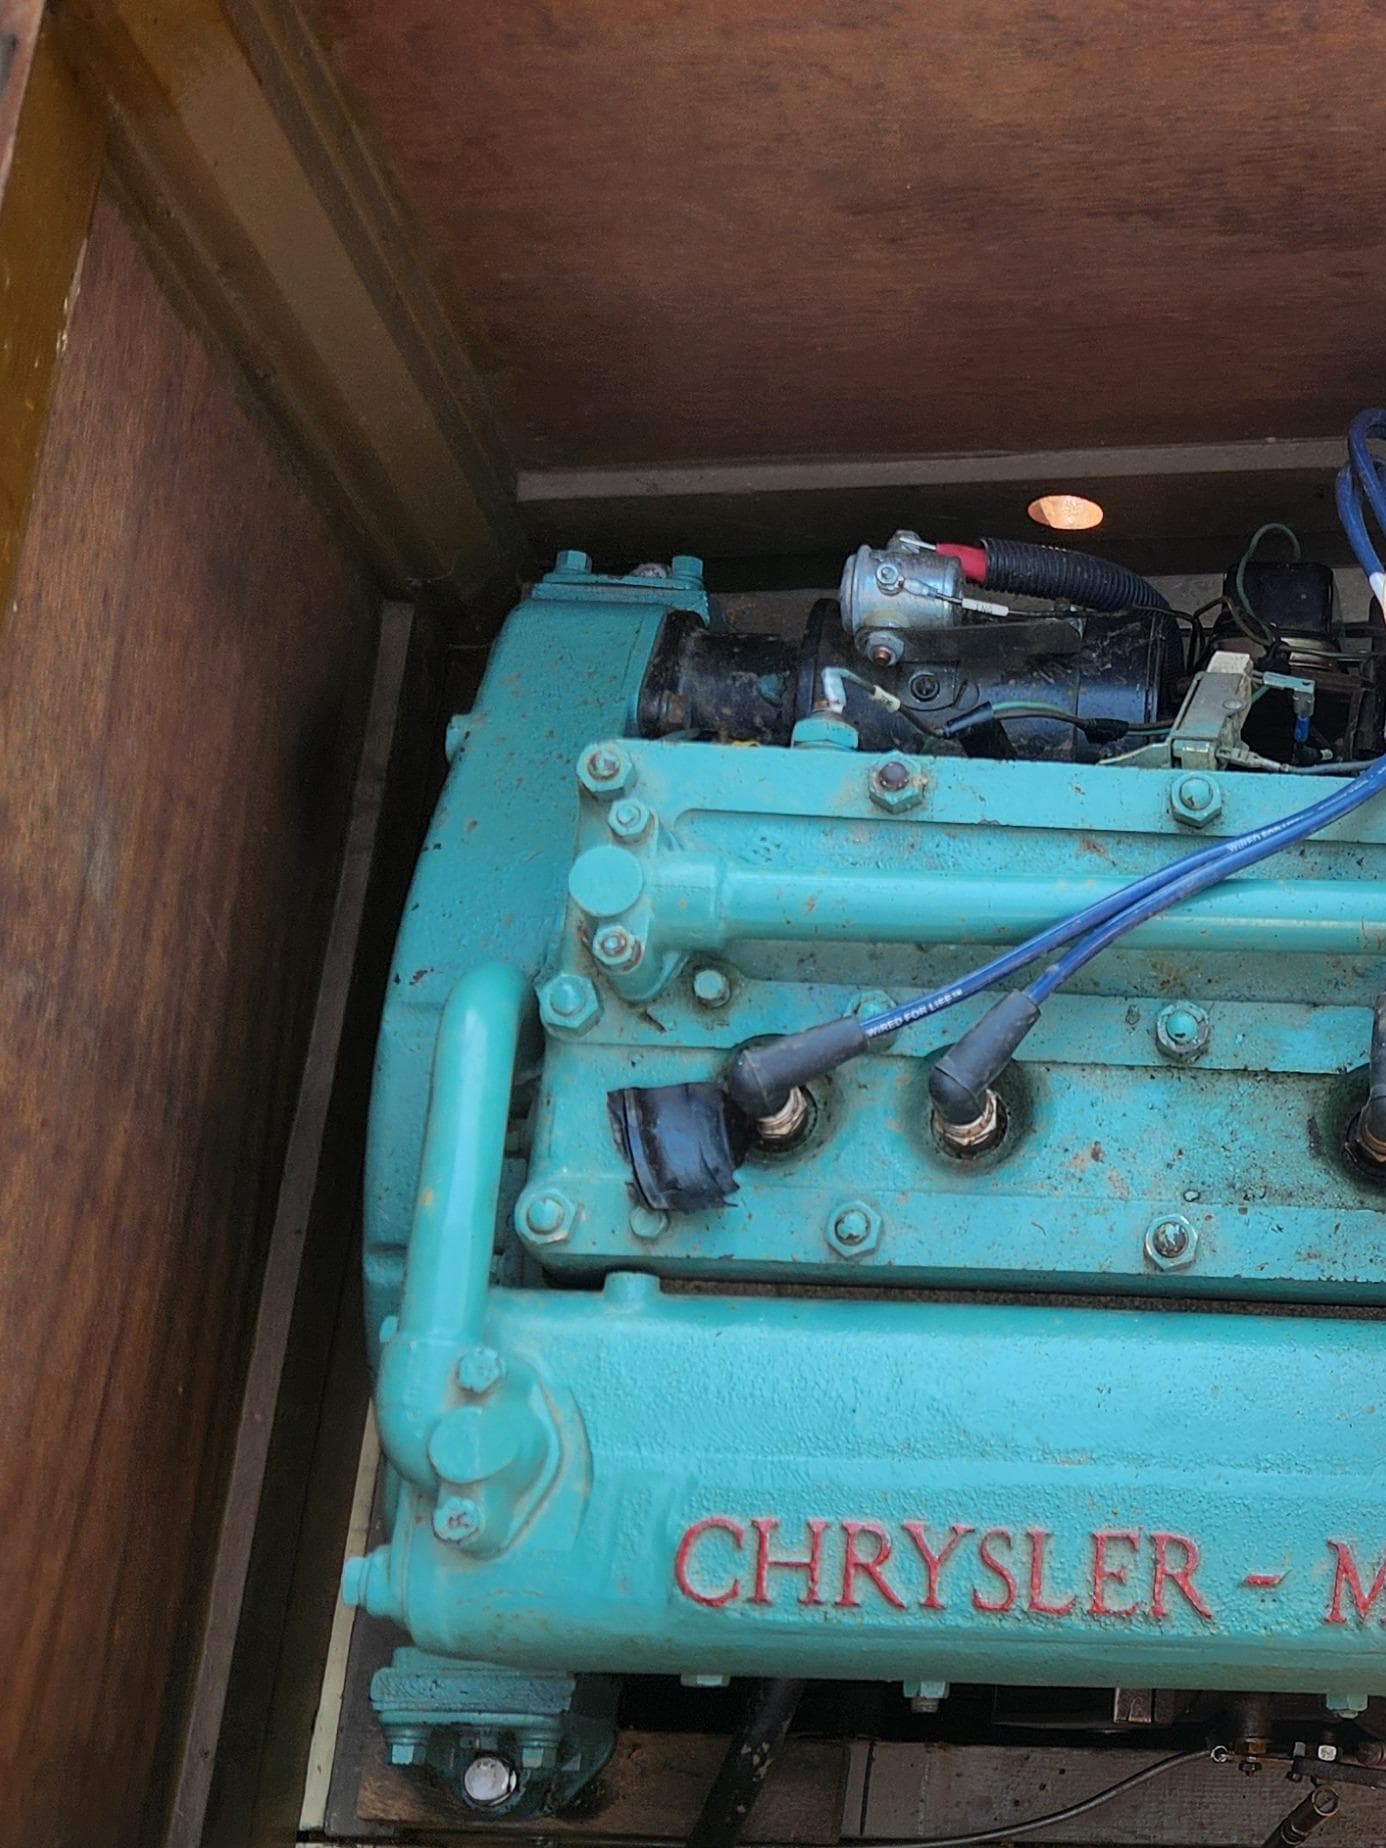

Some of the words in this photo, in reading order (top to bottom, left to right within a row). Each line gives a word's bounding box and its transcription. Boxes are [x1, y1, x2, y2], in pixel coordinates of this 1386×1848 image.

[866, 1016, 904, 1037] WIRED
[903, 1006, 928, 1023] FOR
[674, 1516, 1213, 1620] CHRYSLER
